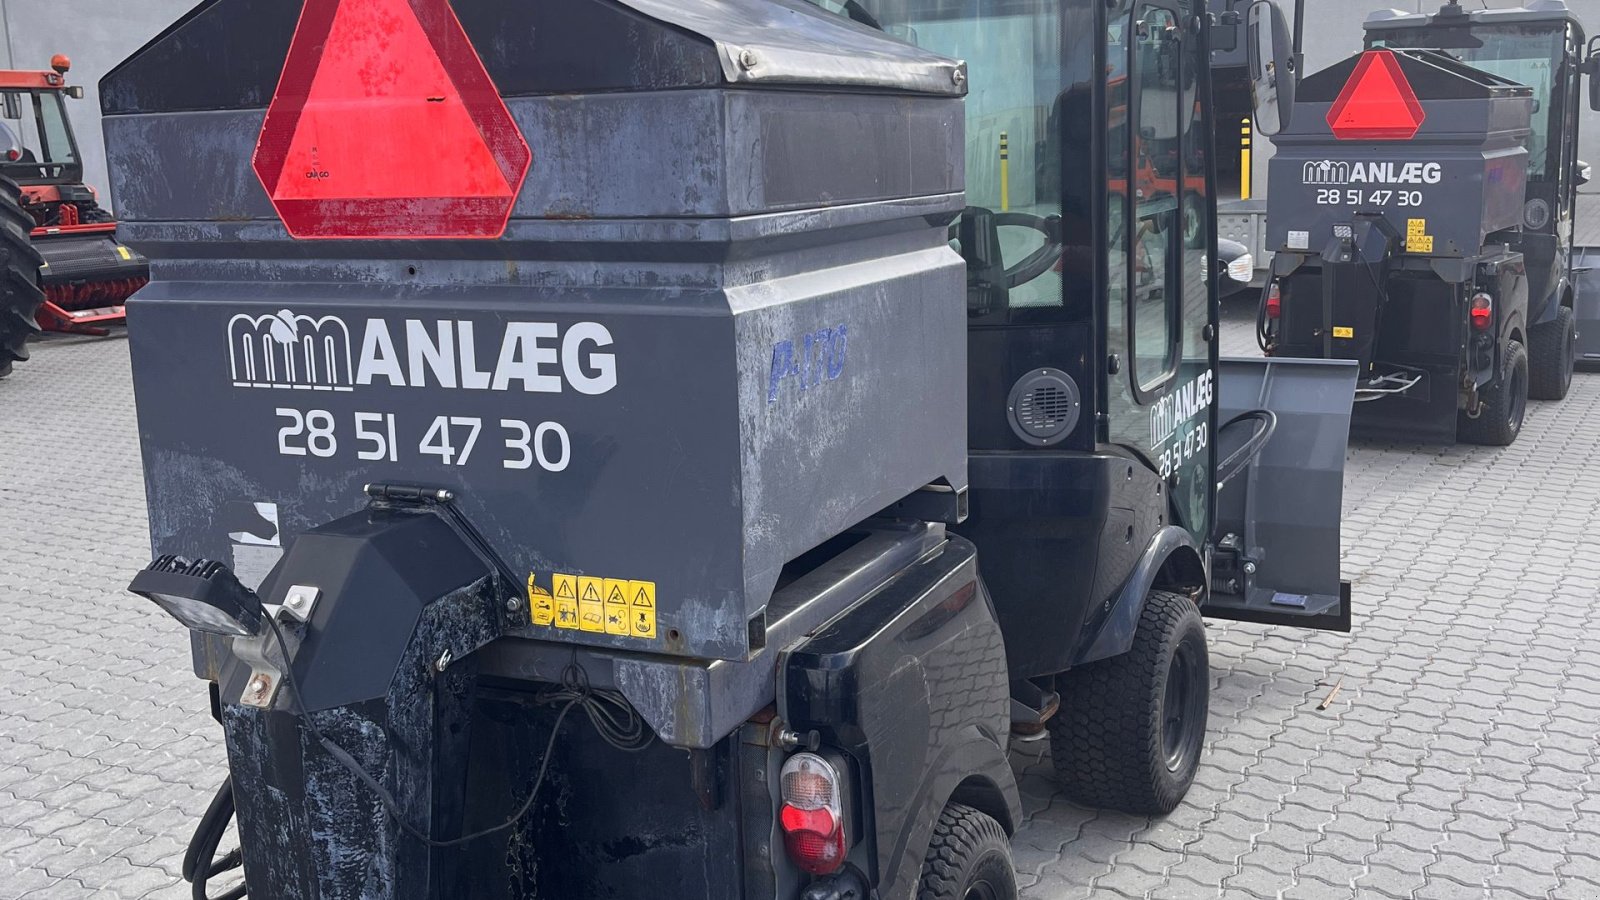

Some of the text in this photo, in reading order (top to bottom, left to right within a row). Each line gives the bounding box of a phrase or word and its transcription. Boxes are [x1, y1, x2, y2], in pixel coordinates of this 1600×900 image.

[1316, 189, 1423, 206] 28 51 47 30
[275, 407, 571, 472] 28 51 47 30
[1158, 421, 1207, 478] 28 51 47 30
